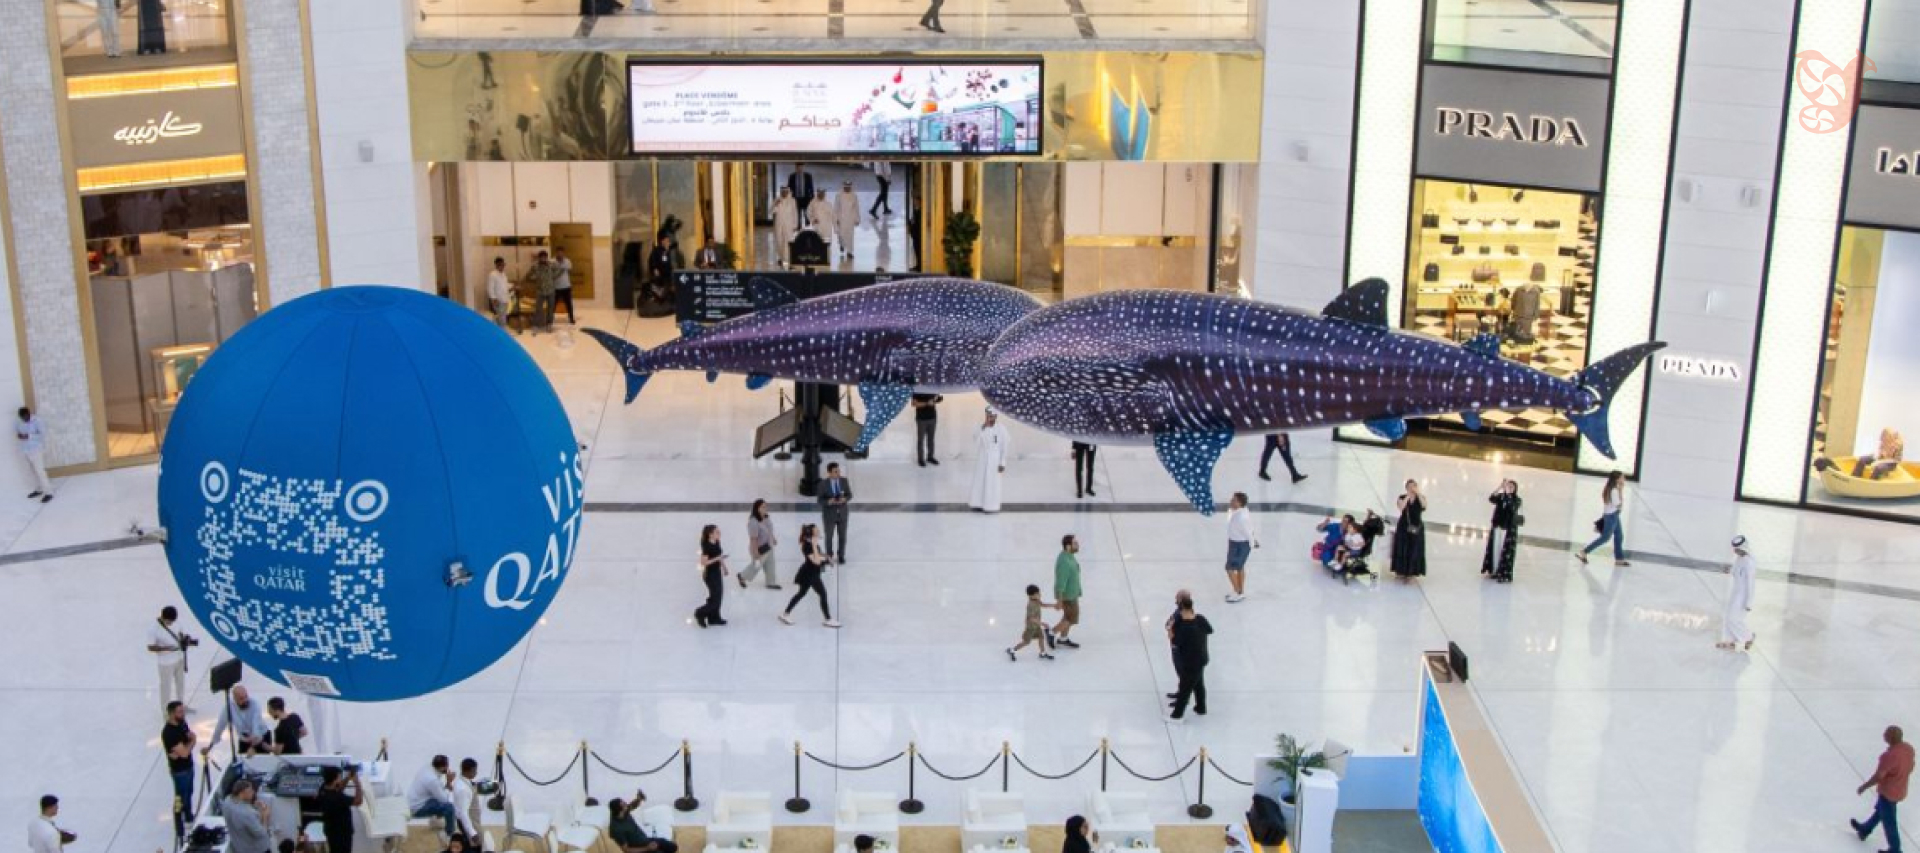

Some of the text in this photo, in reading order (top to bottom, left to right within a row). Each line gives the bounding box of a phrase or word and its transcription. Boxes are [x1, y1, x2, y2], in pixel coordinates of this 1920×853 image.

[113, 110, 203, 145] كارتييه
[1434, 105, 1589, 149] PRADA
[1661, 357, 1740, 381] PRADA
[254, 574, 306, 592] QATAR
[268, 564, 305, 580] visit
